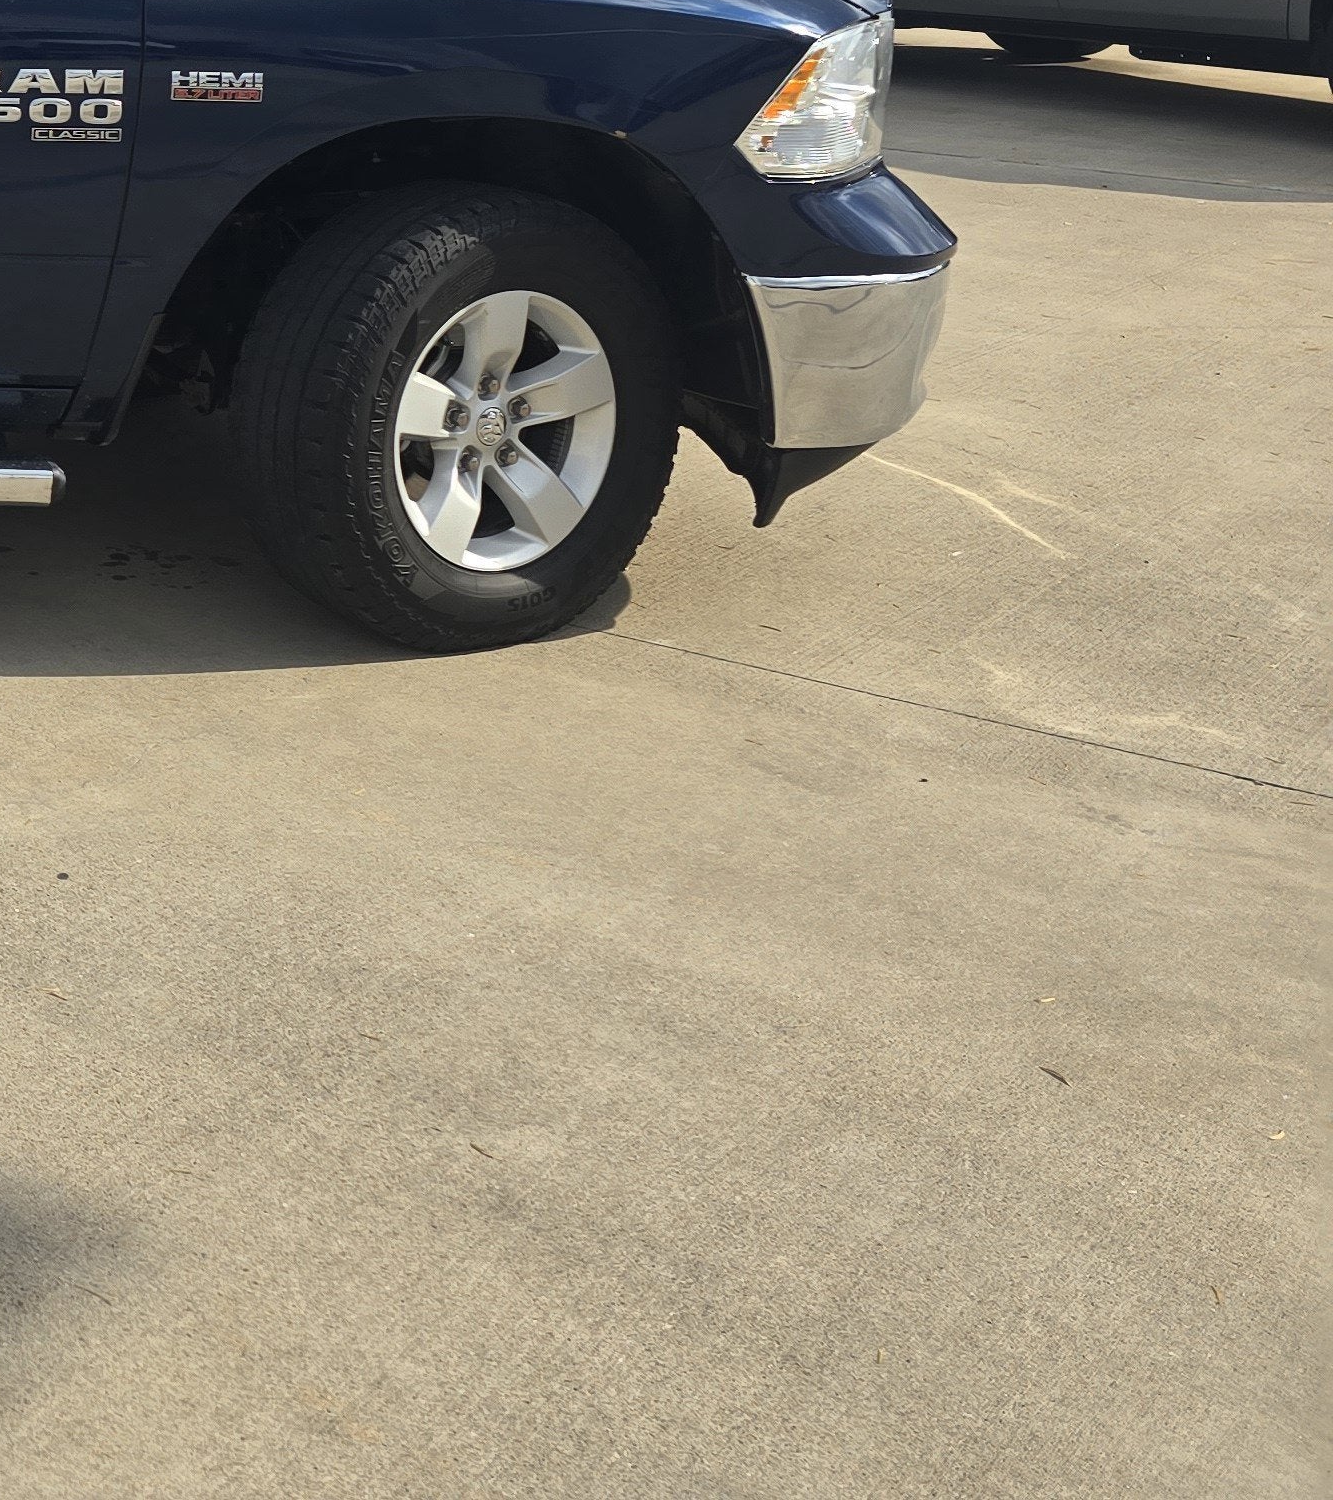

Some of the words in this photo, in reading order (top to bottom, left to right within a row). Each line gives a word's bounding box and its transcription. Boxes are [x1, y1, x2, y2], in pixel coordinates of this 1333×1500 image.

[171, 70, 264, 88] HEMI
[174, 87, 206, 99] 5.7
[207, 88, 260, 100] LITER
[33, 128, 120, 141] CLASSIC
[367, 350, 418, 587] YOKOHAMA
